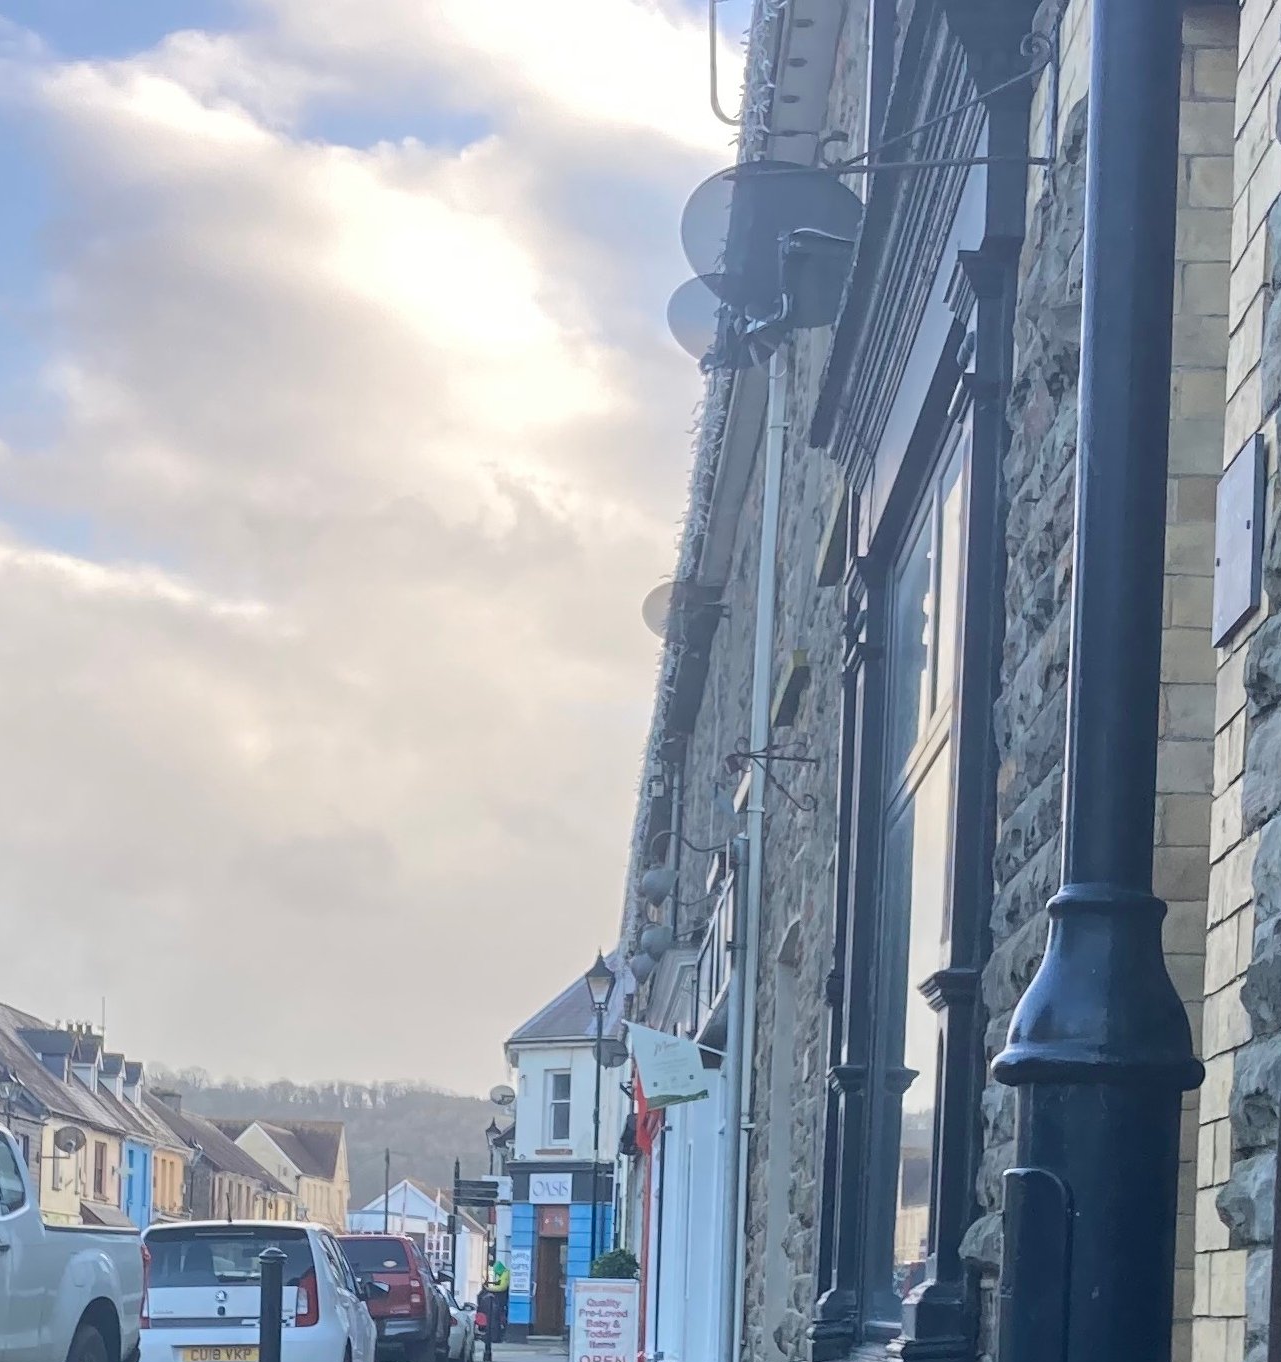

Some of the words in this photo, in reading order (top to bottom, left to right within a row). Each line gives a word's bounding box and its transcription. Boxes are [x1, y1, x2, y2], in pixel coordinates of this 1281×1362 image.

[532, 1181, 569, 1197] OASIS
[586, 1298, 621, 1309] Quality
[579, 1308, 628, 1318] Pre-Loved
[586, 1319, 610, 1329] Baby
[613, 1319, 621, 1328] &
[583, 1329, 622, 1338] Toddler
[589, 1340, 616, 1349] Items
